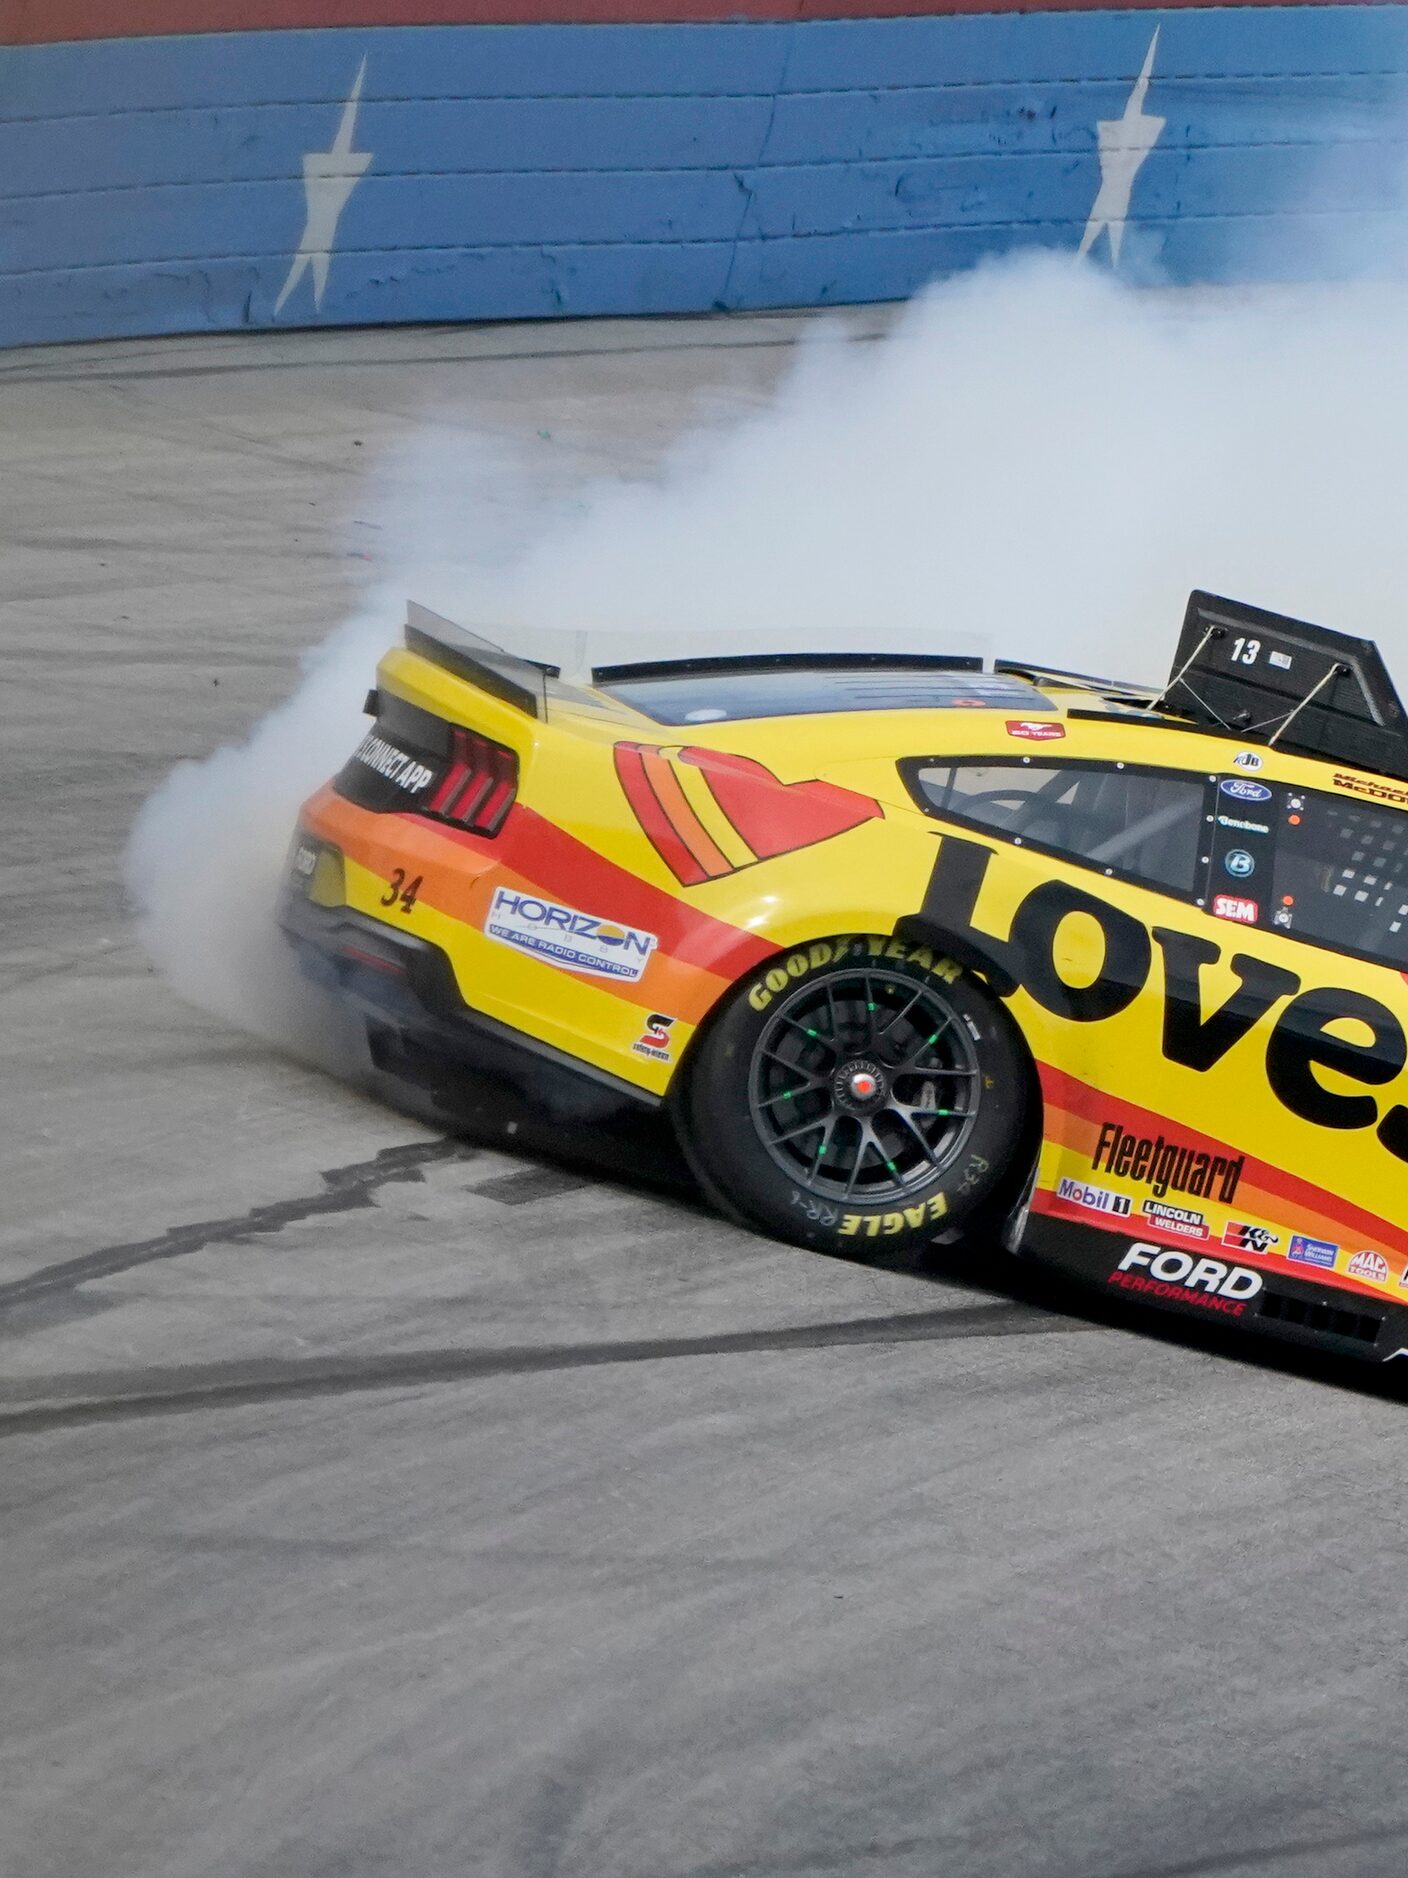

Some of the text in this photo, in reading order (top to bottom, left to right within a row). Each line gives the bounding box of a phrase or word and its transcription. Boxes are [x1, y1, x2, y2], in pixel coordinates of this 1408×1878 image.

[1230, 637, 1261, 665] 13
[395, 761, 433, 794] APP
[381, 868, 424, 914] 34
[494, 891, 651, 956] HORIZON
[1215, 898, 1255, 921] SEM
[490, 925, 638, 978] WE ARE RADIO CONTROL
[1091, 1121, 1246, 1204] Fleetguard
[1058, 1179, 1109, 1210] Mobil
[838, 1192, 949, 1237] EAGLE
[1145, 1201, 1202, 1225] LINCOLN
[1155, 1217, 1203, 1237] WELDERS
[1117, 1242, 1263, 1300] FORD
[1350, 1252, 1386, 1271] MAC
[1350, 1266, 1385, 1281] TOOLS
[1107, 1270, 1249, 1317] PERFORMANCE
